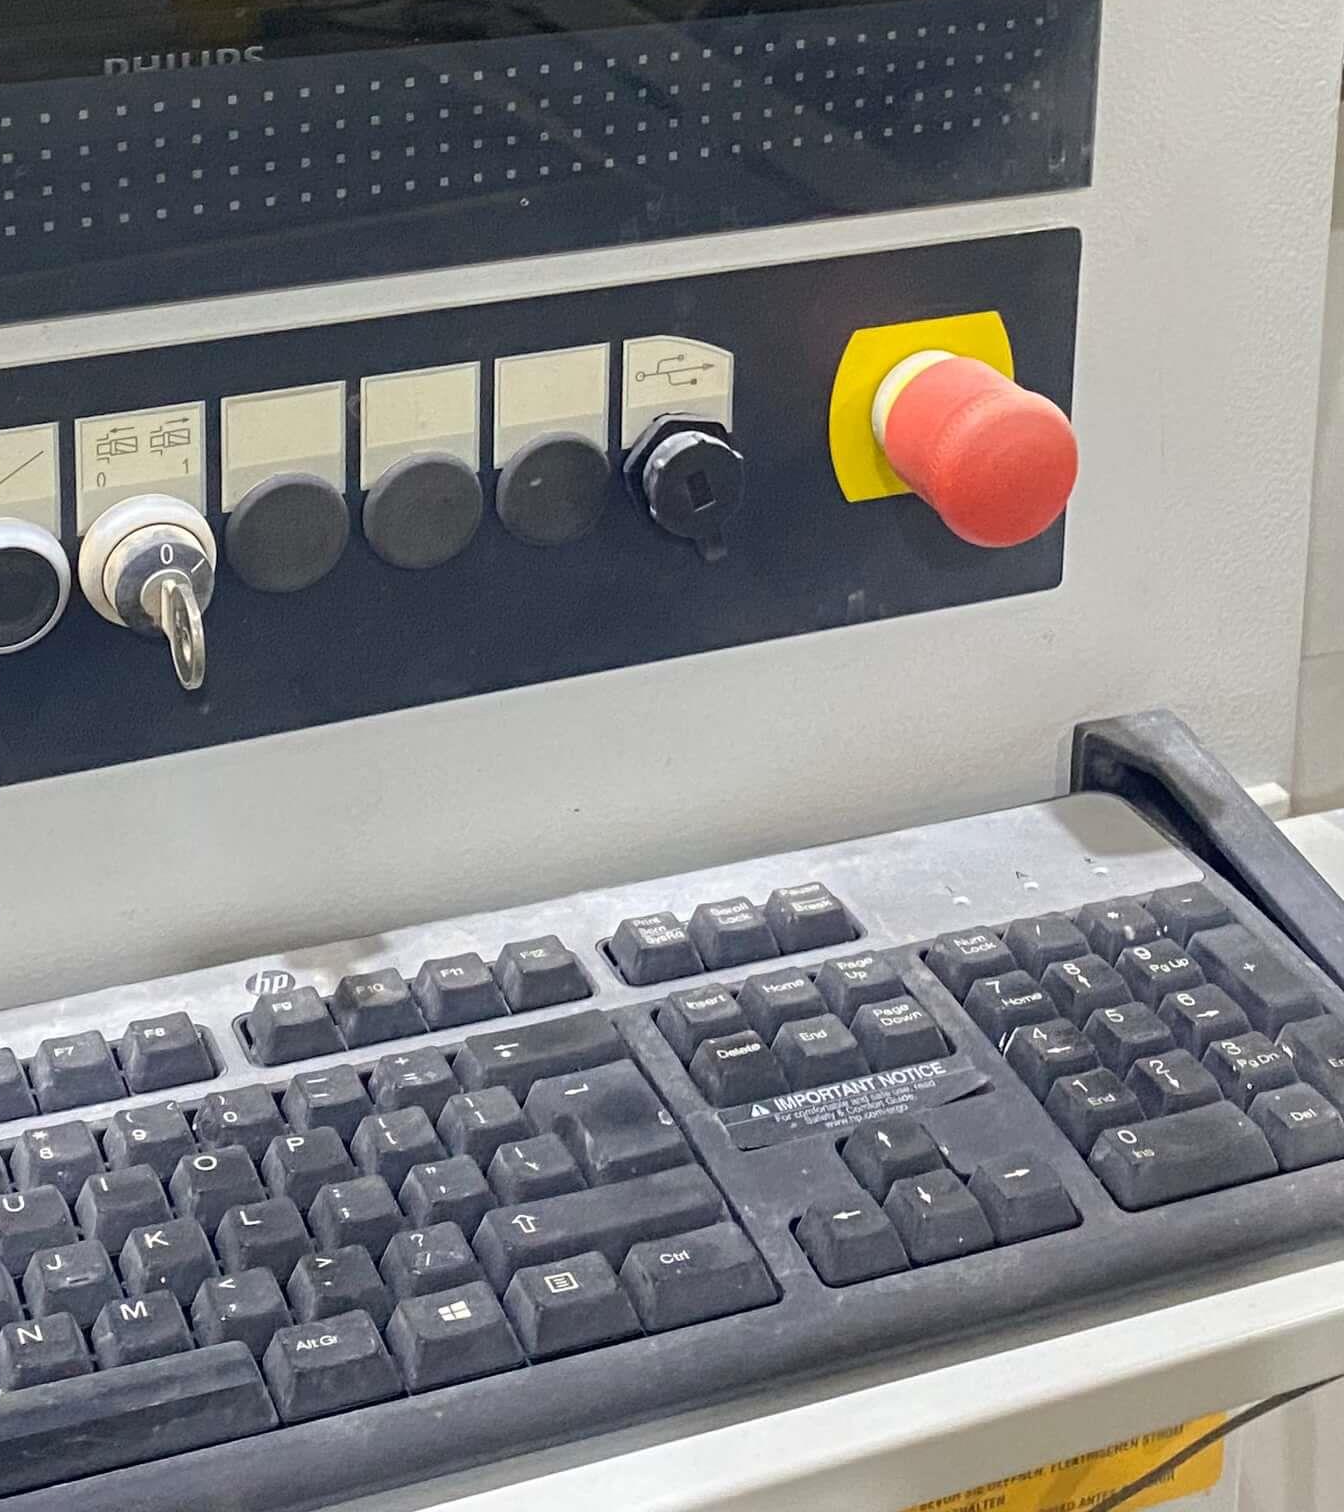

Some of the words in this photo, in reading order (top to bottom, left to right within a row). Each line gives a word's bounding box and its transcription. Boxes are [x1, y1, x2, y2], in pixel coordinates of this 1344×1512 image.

[96, 472, 106, 488] 0
[159, 543, 174, 565] 0
[519, 948, 547, 960] F12
[960, 942, 997, 956] Lock
[1132, 946, 1152, 960] 9
[836, 956, 874, 972] Page
[1062, 962, 1081, 976] 8
[439, 967, 465, 978] F11
[844, 970, 867, 981] Up
[762, 978, 805, 993] Home
[984, 980, 1001, 994] 7
[685, 994, 727, 1010] Insert
[1001, 992, 1043, 1007] Home
[1176, 993, 1196, 1006] 6
[872, 1004, 910, 1021] Page
[880, 1009, 923, 1027] Down
[1104, 1008, 1124, 1023] 5
[143, 1027, 166, 1039] F8
[798, 1029, 828, 1042] End
[1032, 1027, 1048, 1041] 4
[53, 1045, 74, 1057] F7
[716, 1043, 761, 1059] Delete
[1221, 1041, 1242, 1056] 3
[1149, 1059, 1165, 1074] 2
[773, 1078, 878, 1112] IMPORTANT
[880, 1062, 947, 1090] NOTICE
[1072, 1079, 1089, 1093] 1
[1087, 1093, 1116, 1106] End
[222, 1111, 238, 1123] 0
[1289, 1108, 1317, 1122] Del
[131, 1129, 148, 1141] 9
[1116, 1129, 1138, 1144] 0
[285, 1136, 305, 1153] P
[39, 1146, 55, 1160] 8
[1132, 1149, 1155, 1159] Ins
[192, 1155, 218, 1171] O
[99, 1176, 109, 1192] I
[2, 1195, 25, 1212] U
[239, 1210, 262, 1226] L
[143, 1230, 169, 1249] K
[46, 1254, 63, 1271] J
[659, 1249, 690, 1264] Ctrl
[119, 1300, 148, 1321] M
[16, 1324, 44, 1345] N
